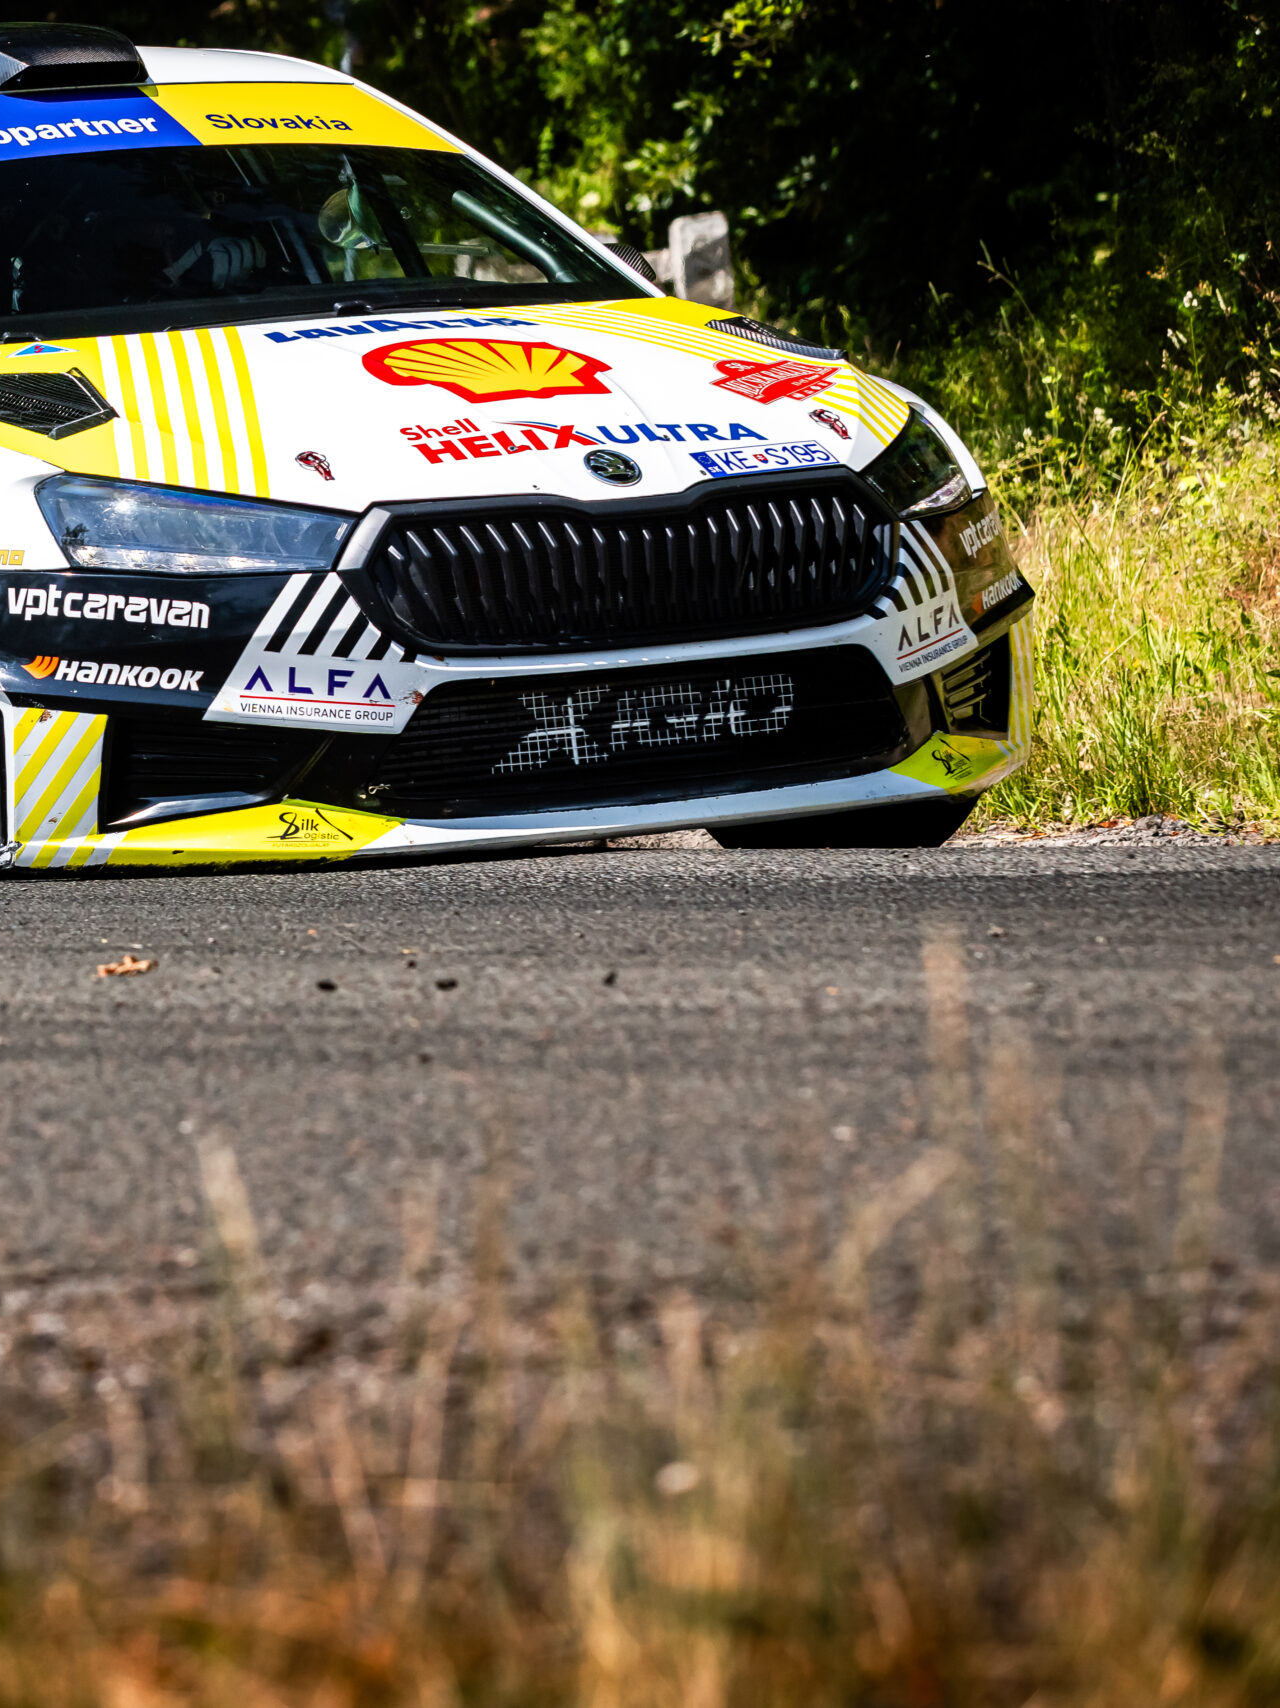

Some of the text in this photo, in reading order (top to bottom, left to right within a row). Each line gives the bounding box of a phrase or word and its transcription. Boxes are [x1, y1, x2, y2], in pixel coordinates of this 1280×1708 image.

[204, 113, 354, 133] Slovakia
[399, 417, 481, 441] Shell
[410, 421, 769, 465] HELIX ULTRA
[714, 450, 759, 471] KE
[764, 443, 832, 466] S195
[898, 601, 960, 652] ALFA
[898, 635, 969, 673] VIENNA INSURANCE GROUP
[243, 665, 392, 699] ALFA
[240, 702, 394, 722] VIENNA INSURANCE GROUP
[279, 811, 320, 841] Silk
